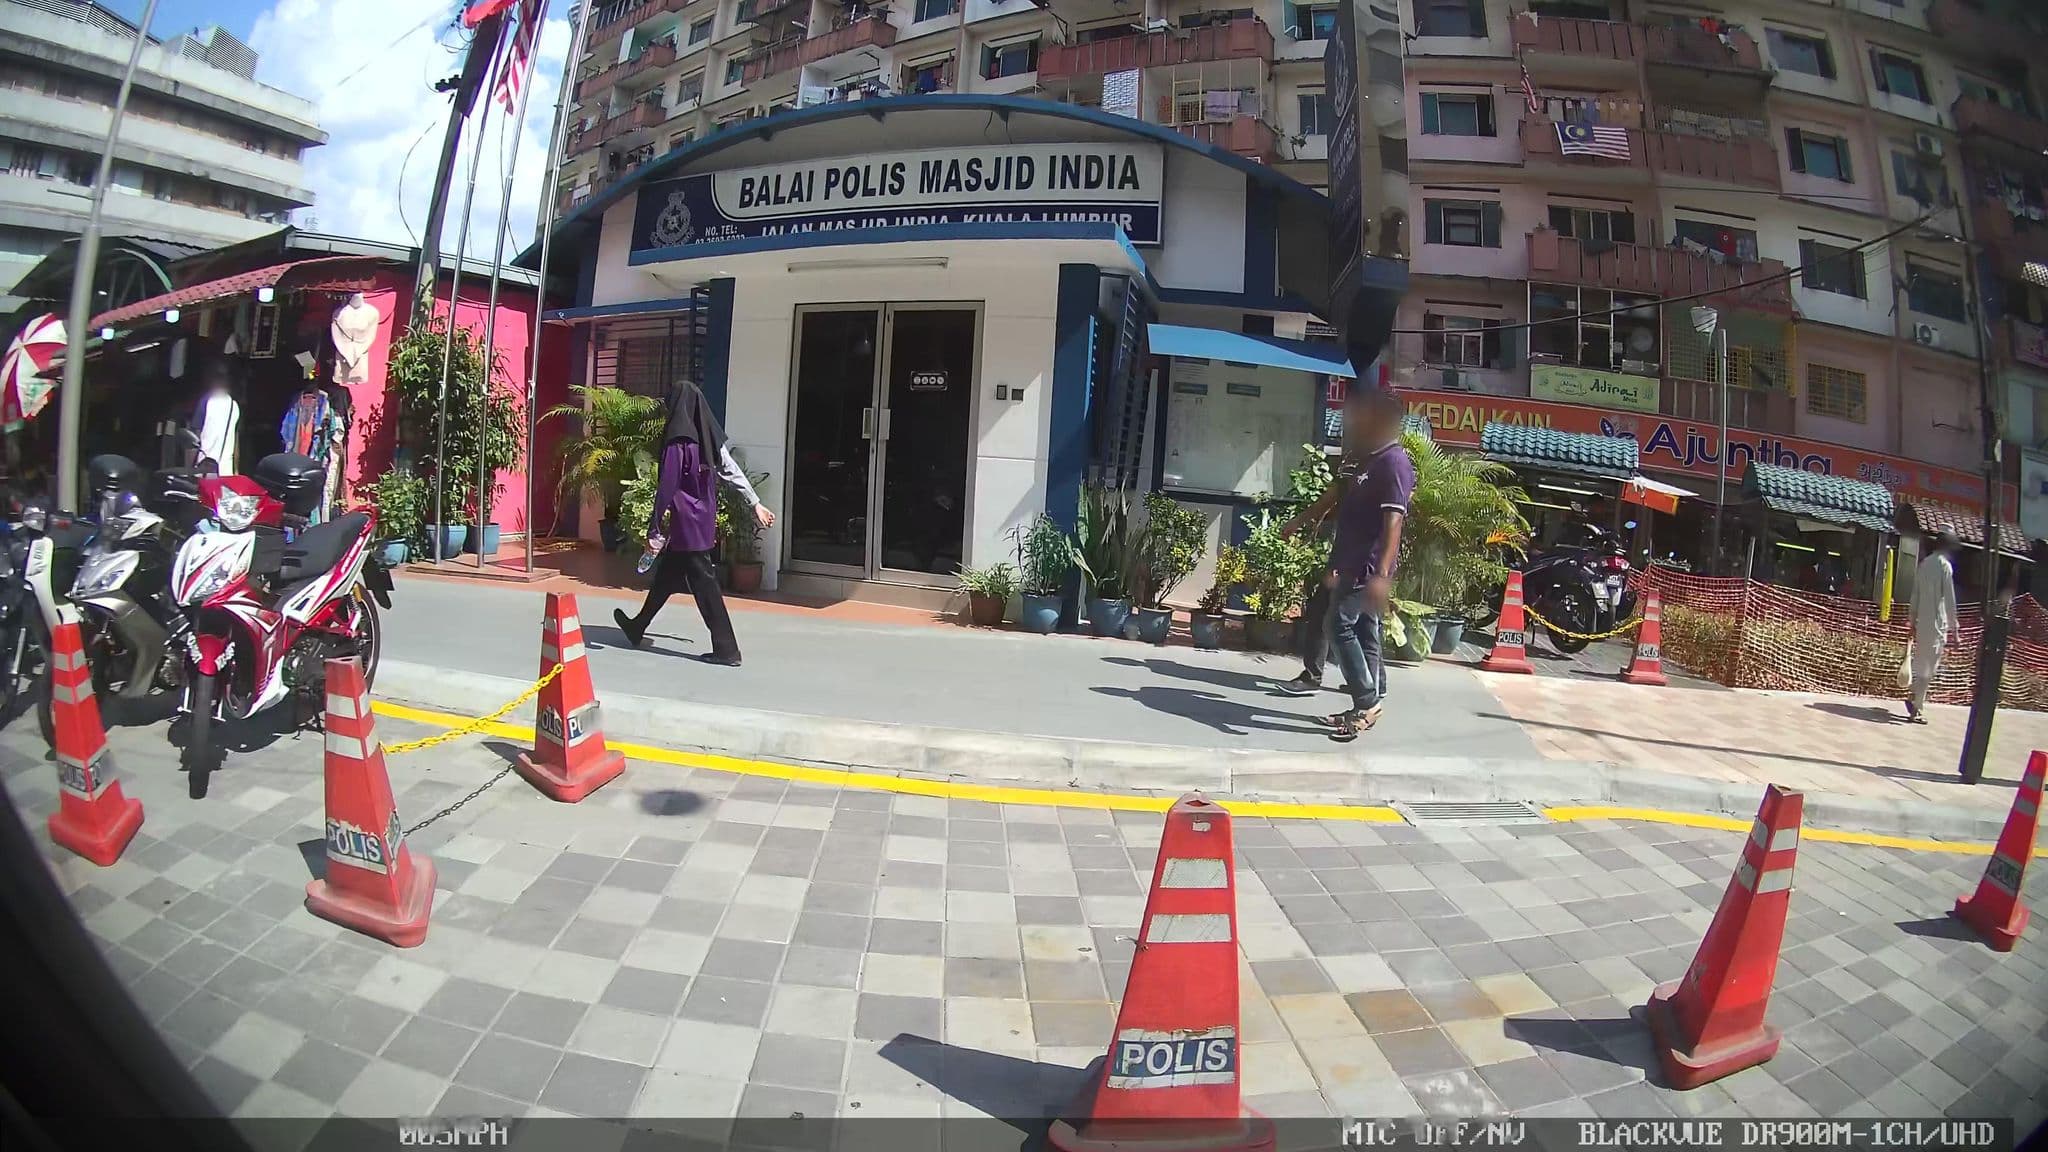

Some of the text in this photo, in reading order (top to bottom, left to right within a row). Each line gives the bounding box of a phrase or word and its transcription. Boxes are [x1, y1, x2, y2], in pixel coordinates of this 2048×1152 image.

[739, 155, 1140, 209] BALAI POLIS MASJID INDIA
[705, 224, 738, 236] NO. TEL:
[1408, 401, 1485, 433] KEDAI
[1643, 423, 1832, 476] Ajuntha
[1498, 631, 1523, 645] POLIS
[327, 823, 381, 862] POLIS
[1121, 1039, 1228, 1075] POLIS
